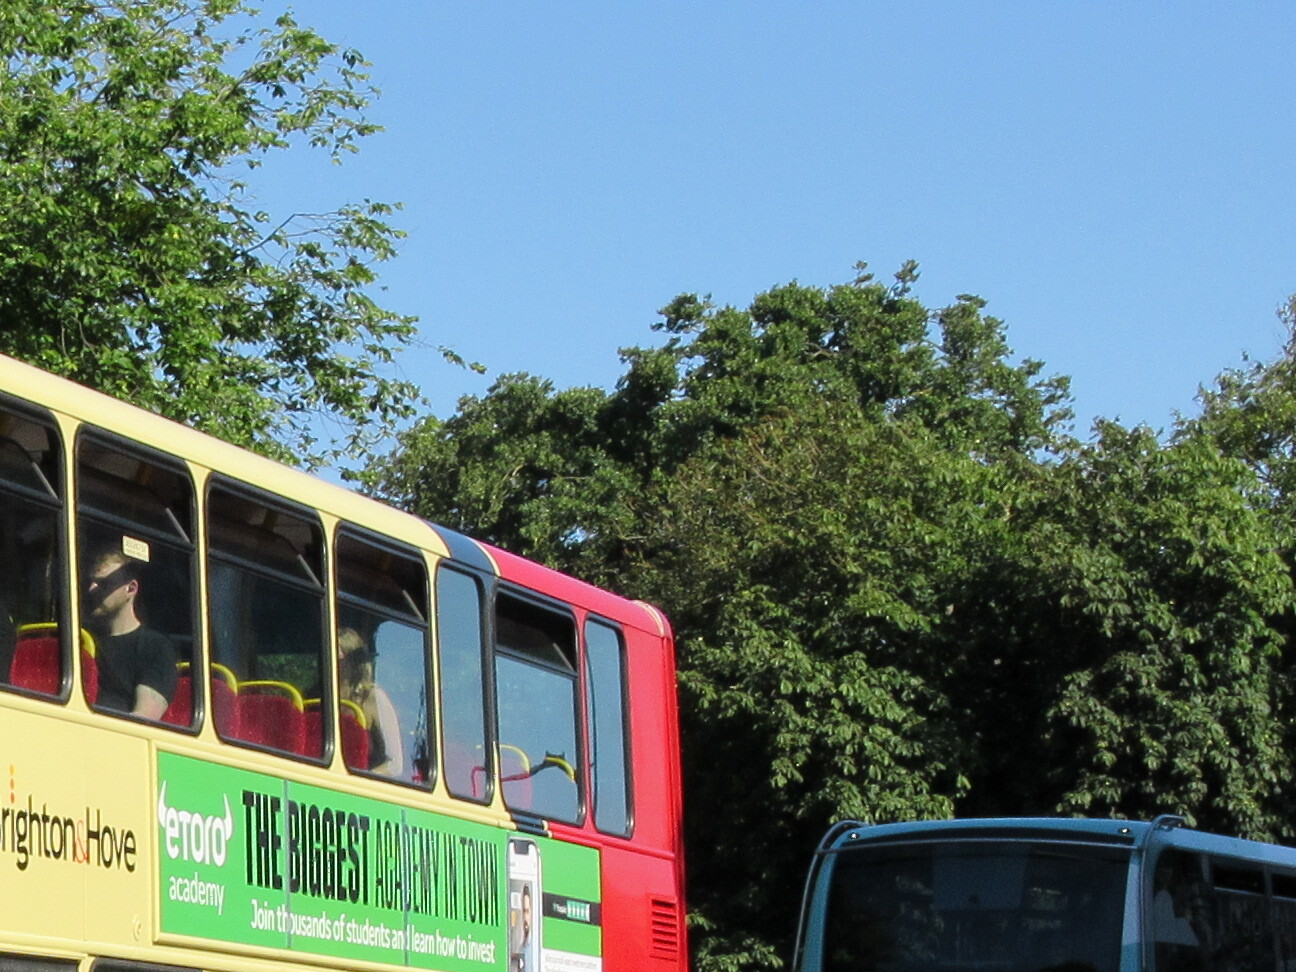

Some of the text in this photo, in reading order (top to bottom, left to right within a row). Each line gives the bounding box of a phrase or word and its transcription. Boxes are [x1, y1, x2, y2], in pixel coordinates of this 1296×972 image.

[242, 789, 500, 928] THE BIGGEST ACADEMY IN TOWN
[169, 871, 225, 917] academy
[251, 899, 274, 931] Join
[333, 914, 345, 943] of
[346, 919, 390, 950] students
[391, 924, 410, 951] and
[411, 926, 435, 956] learn
[435, 929, 455, 957] how
[455, 935, 467, 960] to
[467, 935, 496, 965] invest
